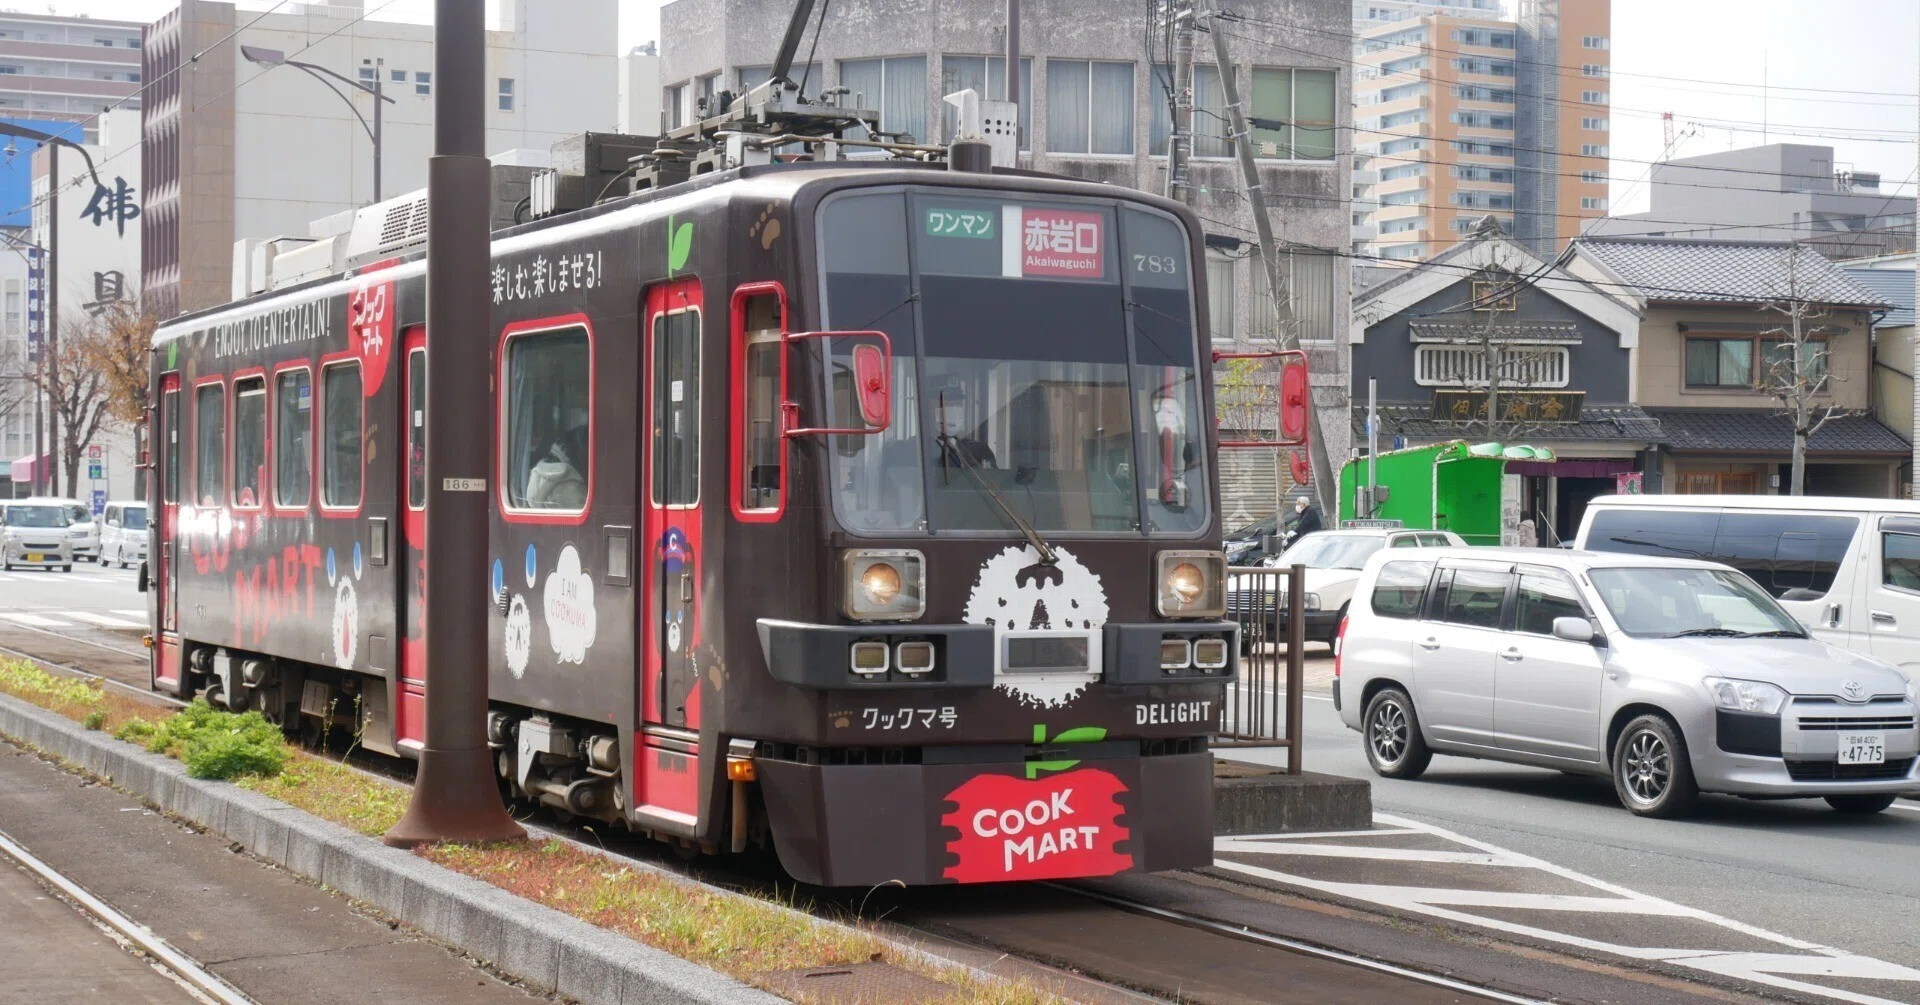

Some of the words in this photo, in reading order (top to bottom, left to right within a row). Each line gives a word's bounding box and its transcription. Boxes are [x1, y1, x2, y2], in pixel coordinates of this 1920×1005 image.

[929, 212, 991, 235] ワンマン
[1025, 217, 1098, 254] 赤岩口
[1025, 255, 1096, 270] Akaiwaguchi
[1132, 254, 1176, 274] 783
[215, 320, 249, 358] ENJOY,
[249, 316, 262, 351] TO
[263, 297, 331, 348] ENTERTAIN!
[362, 325, 383, 356] マート
[452, 479, 469, 490] 86
[235, 543, 321, 649] MART
[862, 705, 958, 731] クックマ号
[1849, 746, 1882, 762] 47-75
[972, 788, 1075, 838] COOK
[1004, 825, 1100, 872] MART
